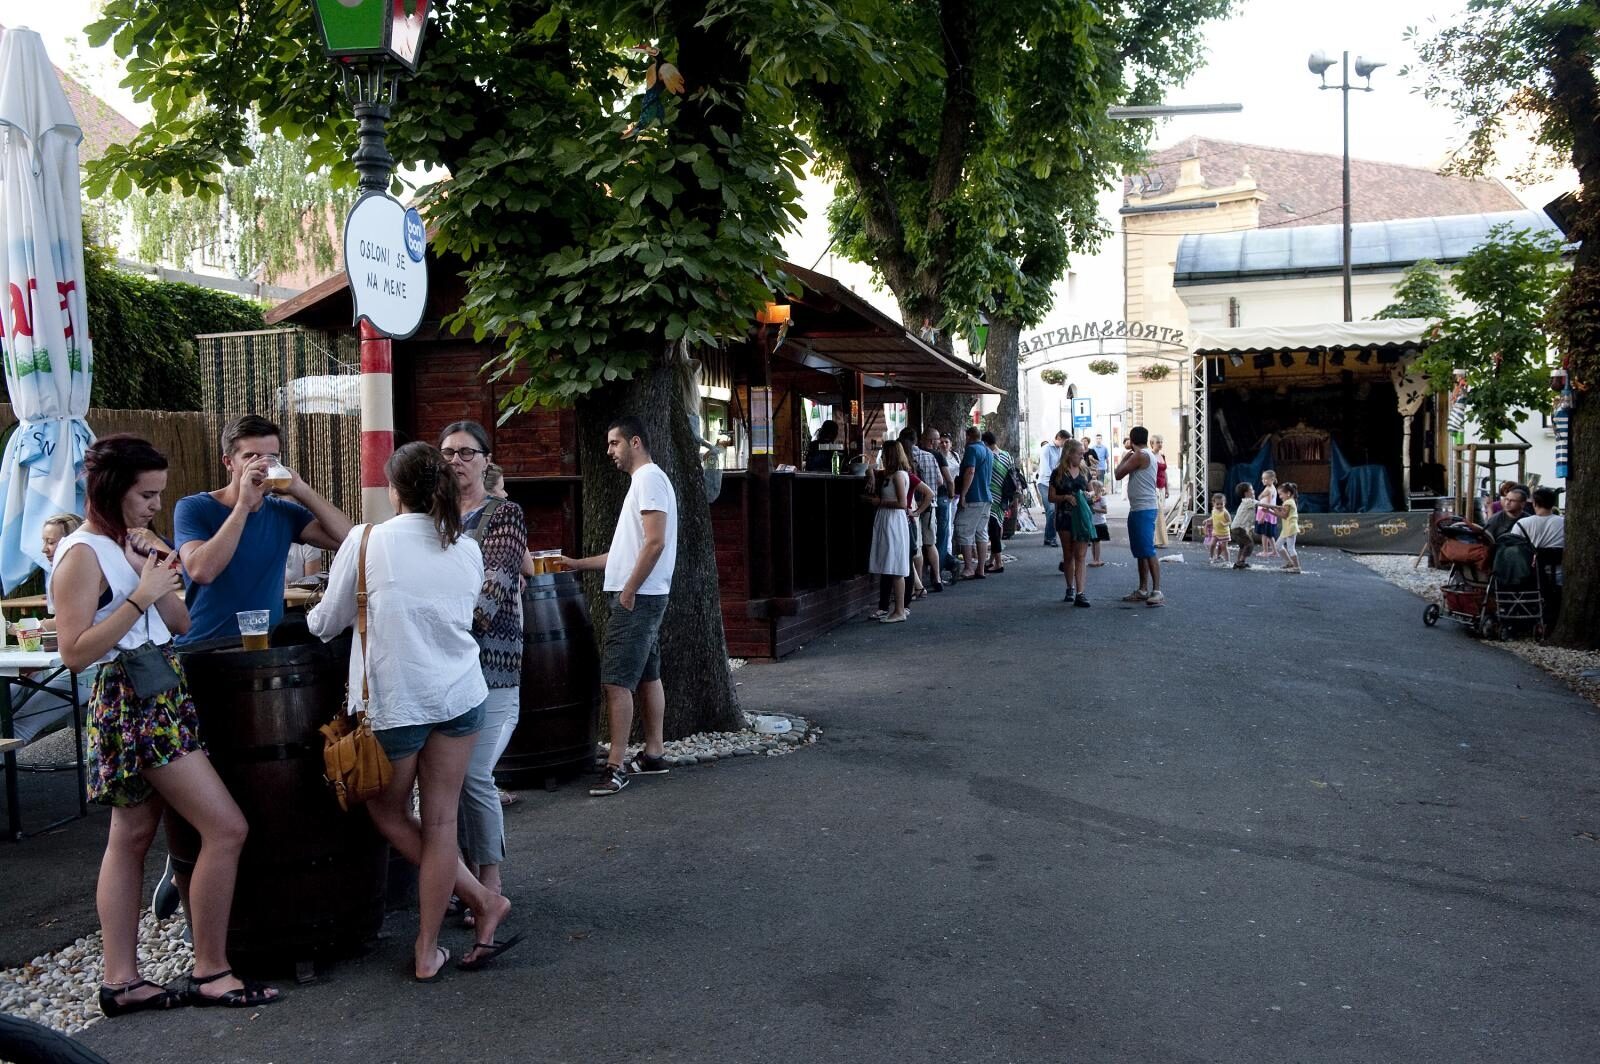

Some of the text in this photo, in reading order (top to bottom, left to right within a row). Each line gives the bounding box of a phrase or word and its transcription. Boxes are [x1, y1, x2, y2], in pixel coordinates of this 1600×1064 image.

[407, 217, 421, 237] bon
[360, 240, 406, 270] OSLONI SE
[366, 273, 407, 299] NA MENE
